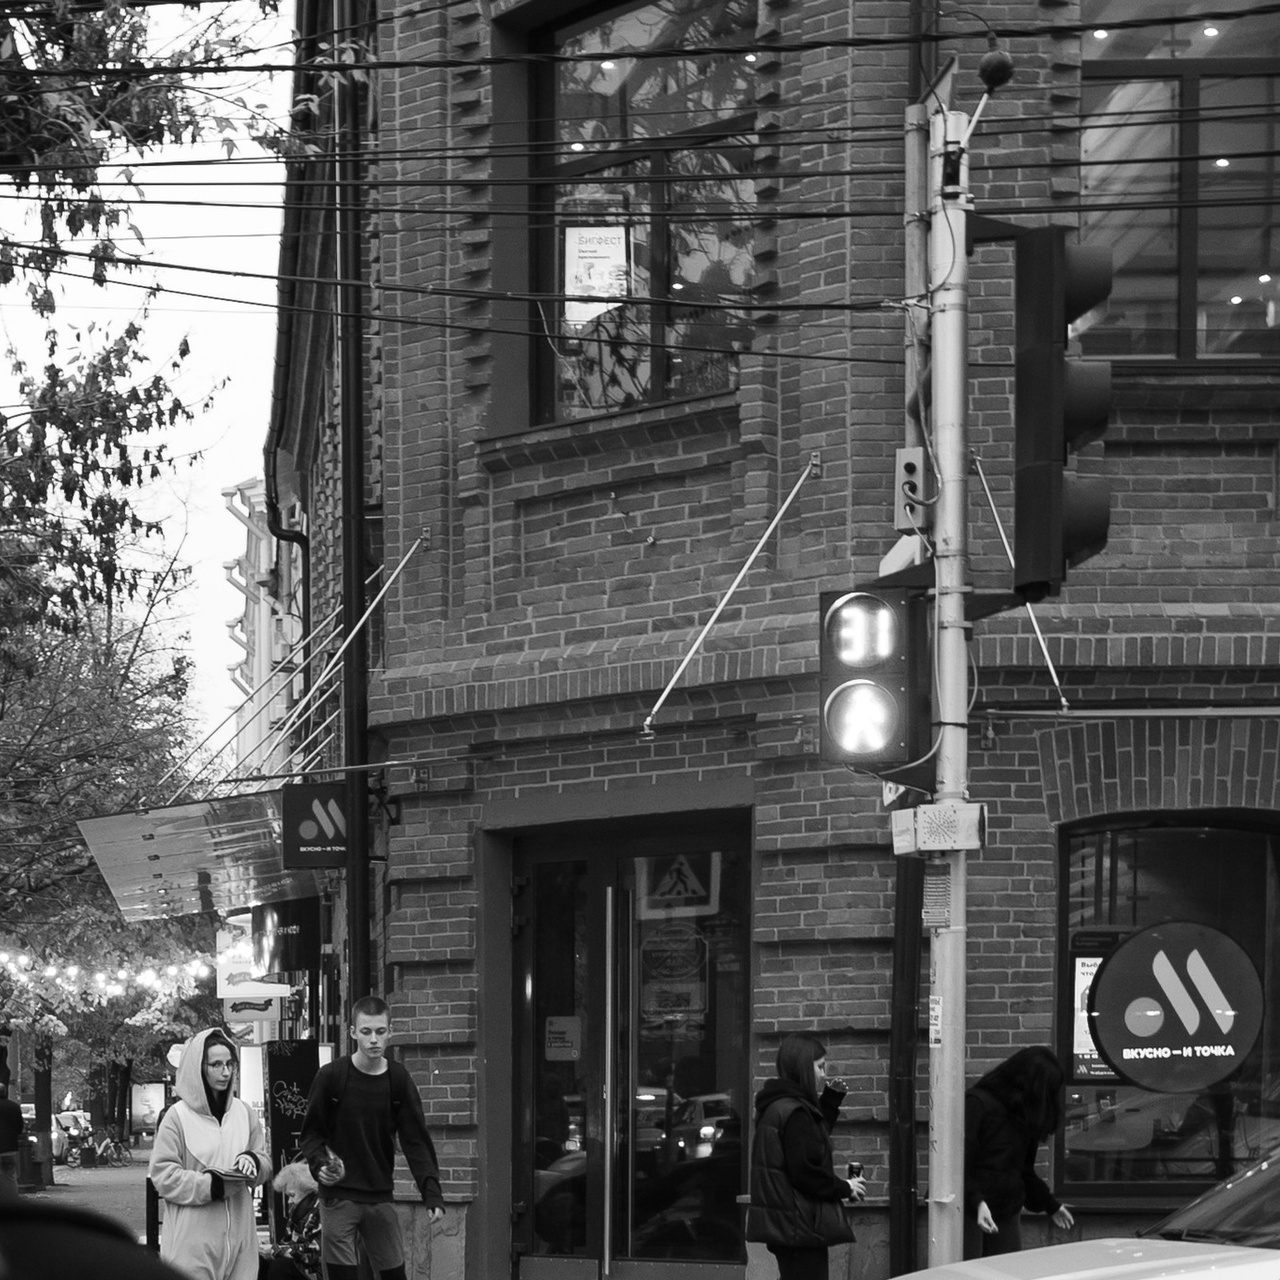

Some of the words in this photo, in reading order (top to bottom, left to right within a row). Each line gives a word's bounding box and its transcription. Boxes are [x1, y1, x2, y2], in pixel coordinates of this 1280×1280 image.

[839, 606, 891, 662] 31
[1122, 1047, 1171, 1059] ВКУСНО
[1193, 1045, 1235, 1057] ТОЧКА
